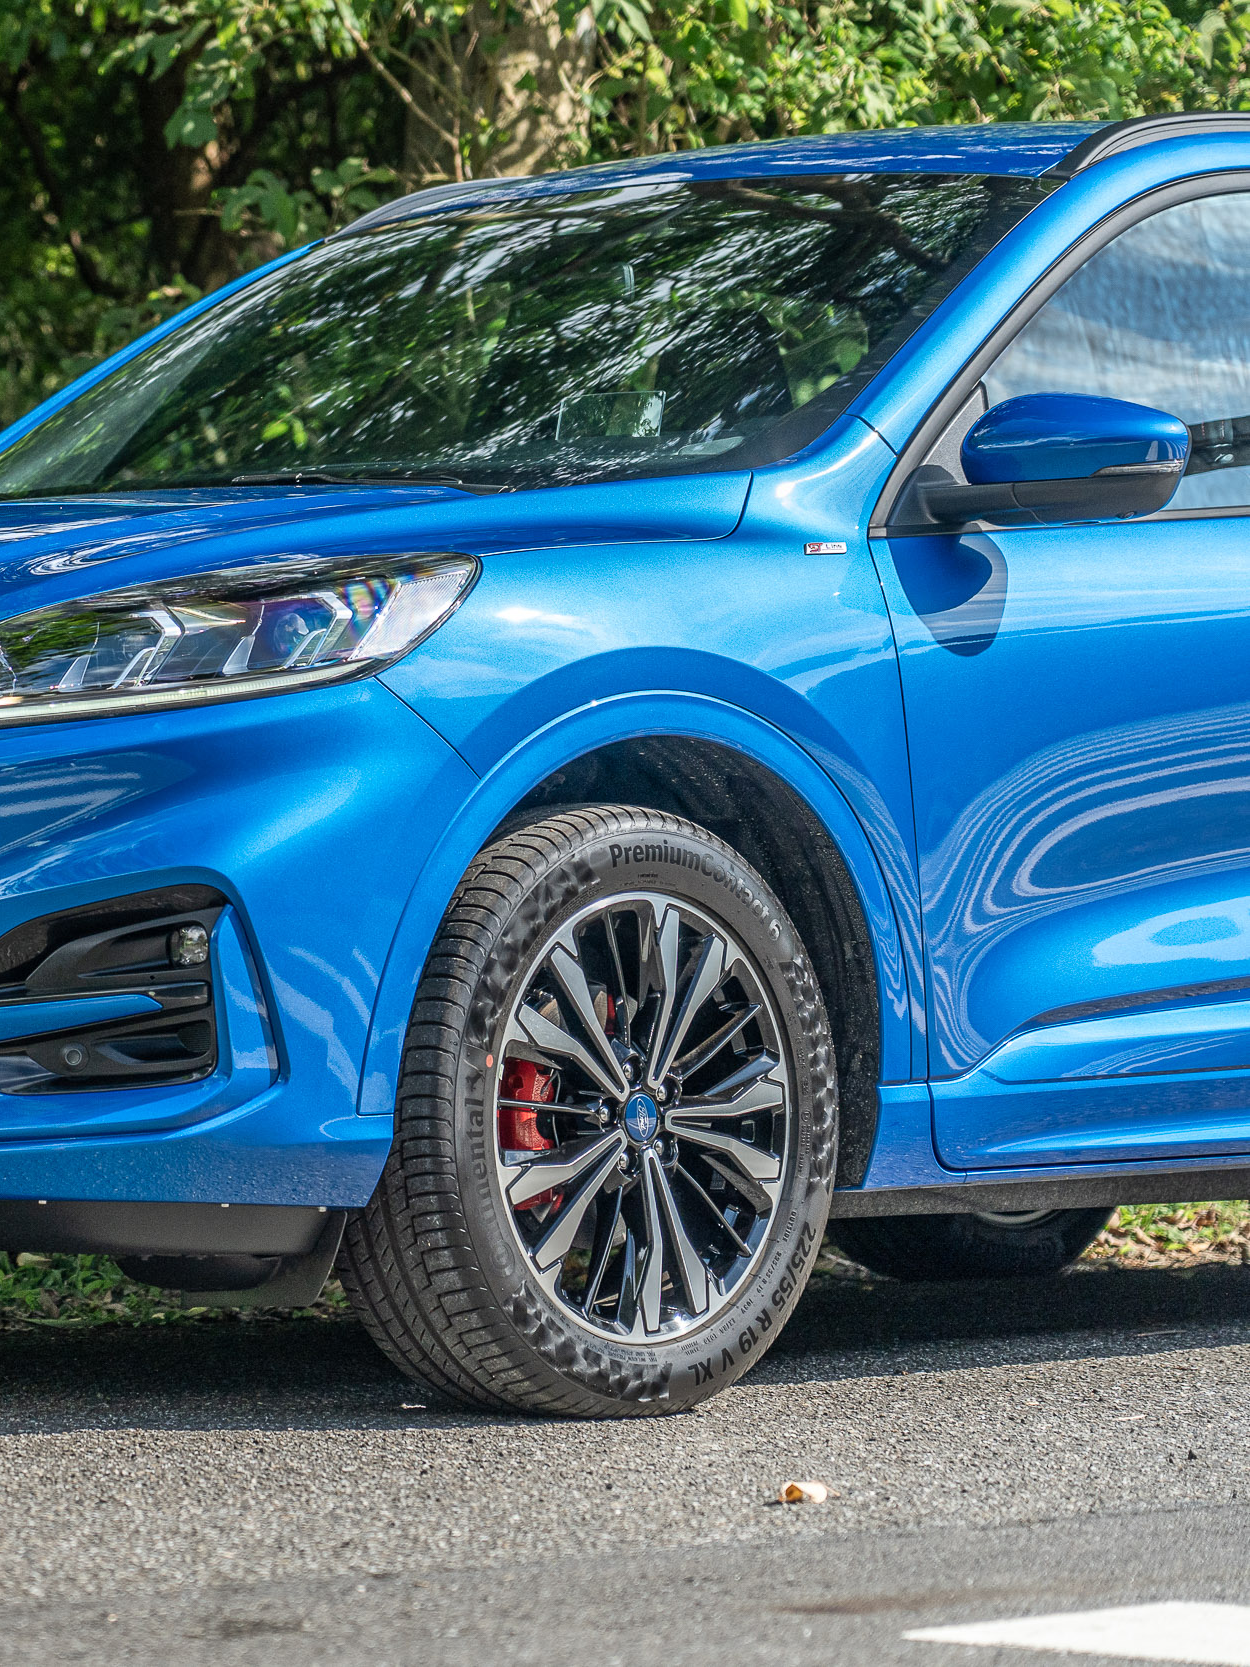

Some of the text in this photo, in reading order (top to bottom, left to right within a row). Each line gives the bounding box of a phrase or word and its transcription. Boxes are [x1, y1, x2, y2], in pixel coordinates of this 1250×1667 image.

[609, 840, 781, 941] PremiumContact 6
[771, 1221, 816, 1313] 225/55
[755, 1308, 773, 1332] R
[738, 1325, 759, 1354] 19
[688, 1358, 714, 1386] XL
[721, 1347, 734, 1372] V
